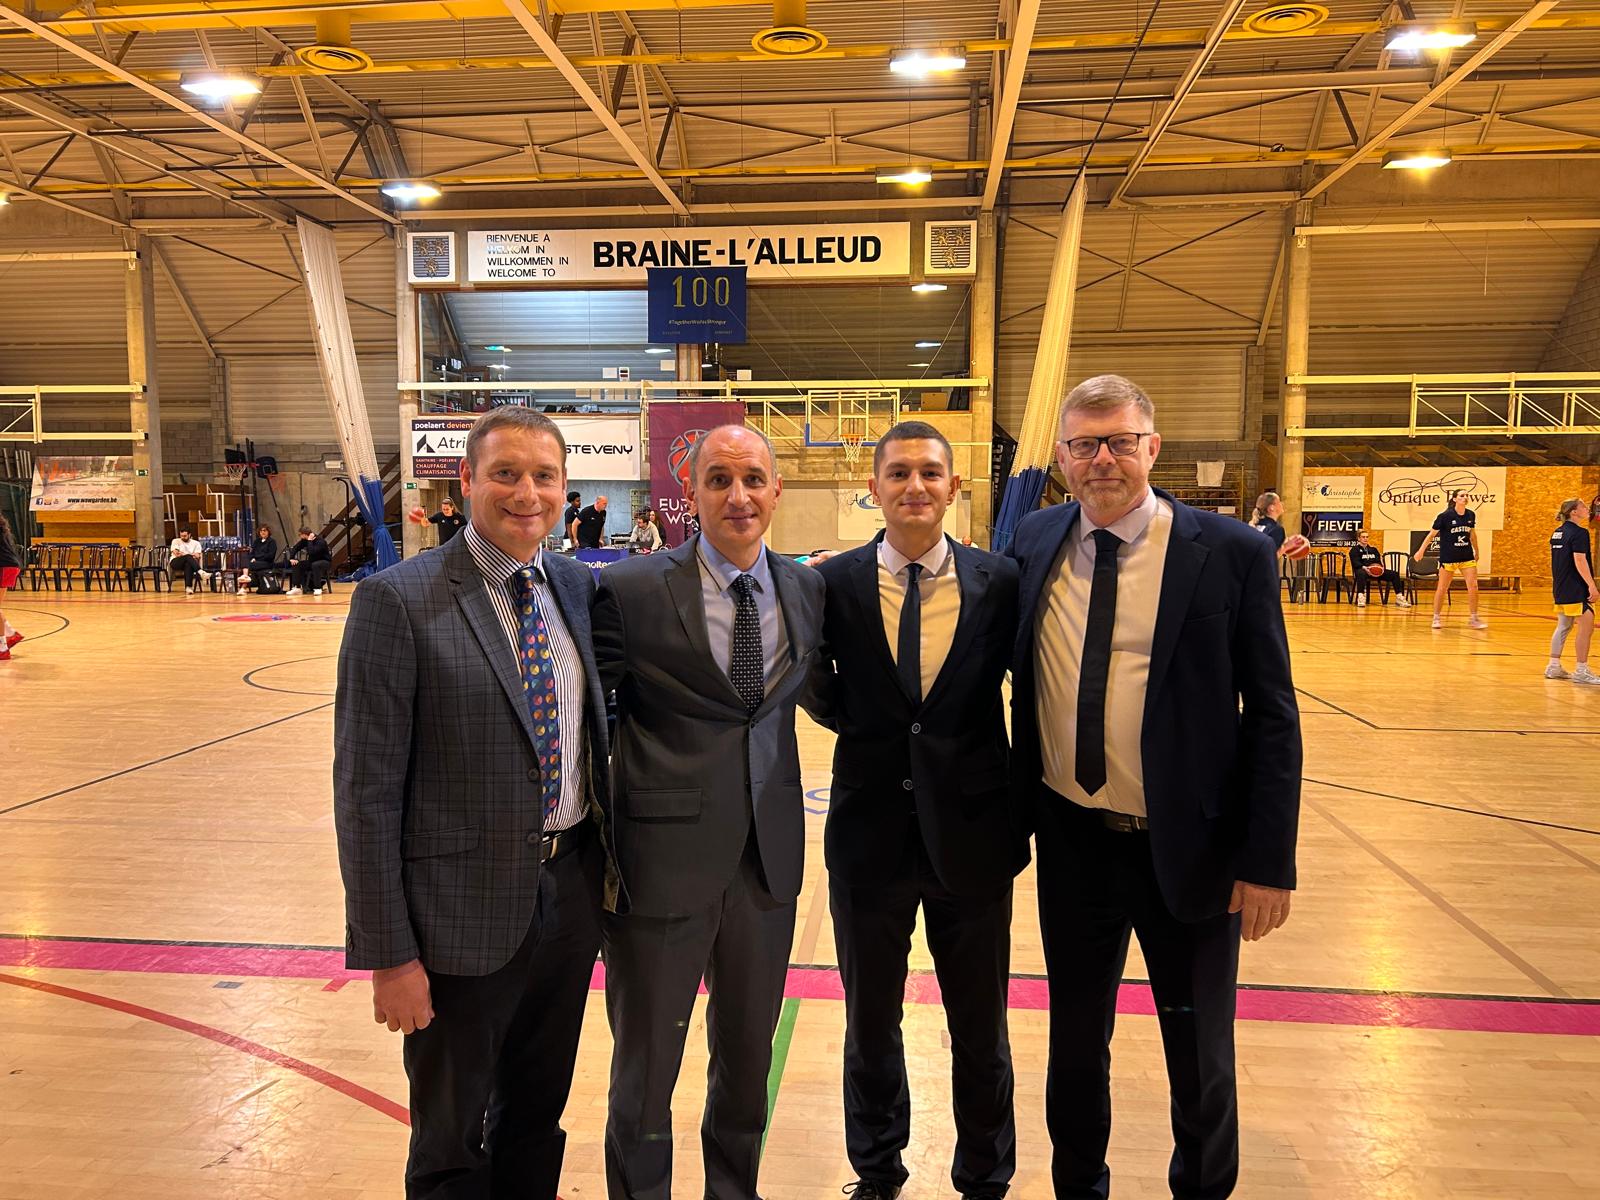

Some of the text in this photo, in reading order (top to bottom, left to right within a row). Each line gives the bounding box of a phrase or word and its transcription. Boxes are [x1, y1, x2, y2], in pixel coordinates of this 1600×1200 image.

[486, 234, 539, 243] BIENVENUE
[487, 245, 545, 254] WELKOM IN
[487, 256, 569, 266] WILLKOMMEN IN
[488, 268, 556, 277] WELCOME TO
[672, 275, 730, 308] 100
[415, 422, 446, 430] poelaert
[437, 436, 466, 449] Atri
[566, 444, 633, 454] STEVENY
[1379, 490, 1440, 506] Optique
[659, 498, 688, 511] EUR
[665, 512, 693, 525] WO
[1317, 520, 1361, 531] FIEVET
